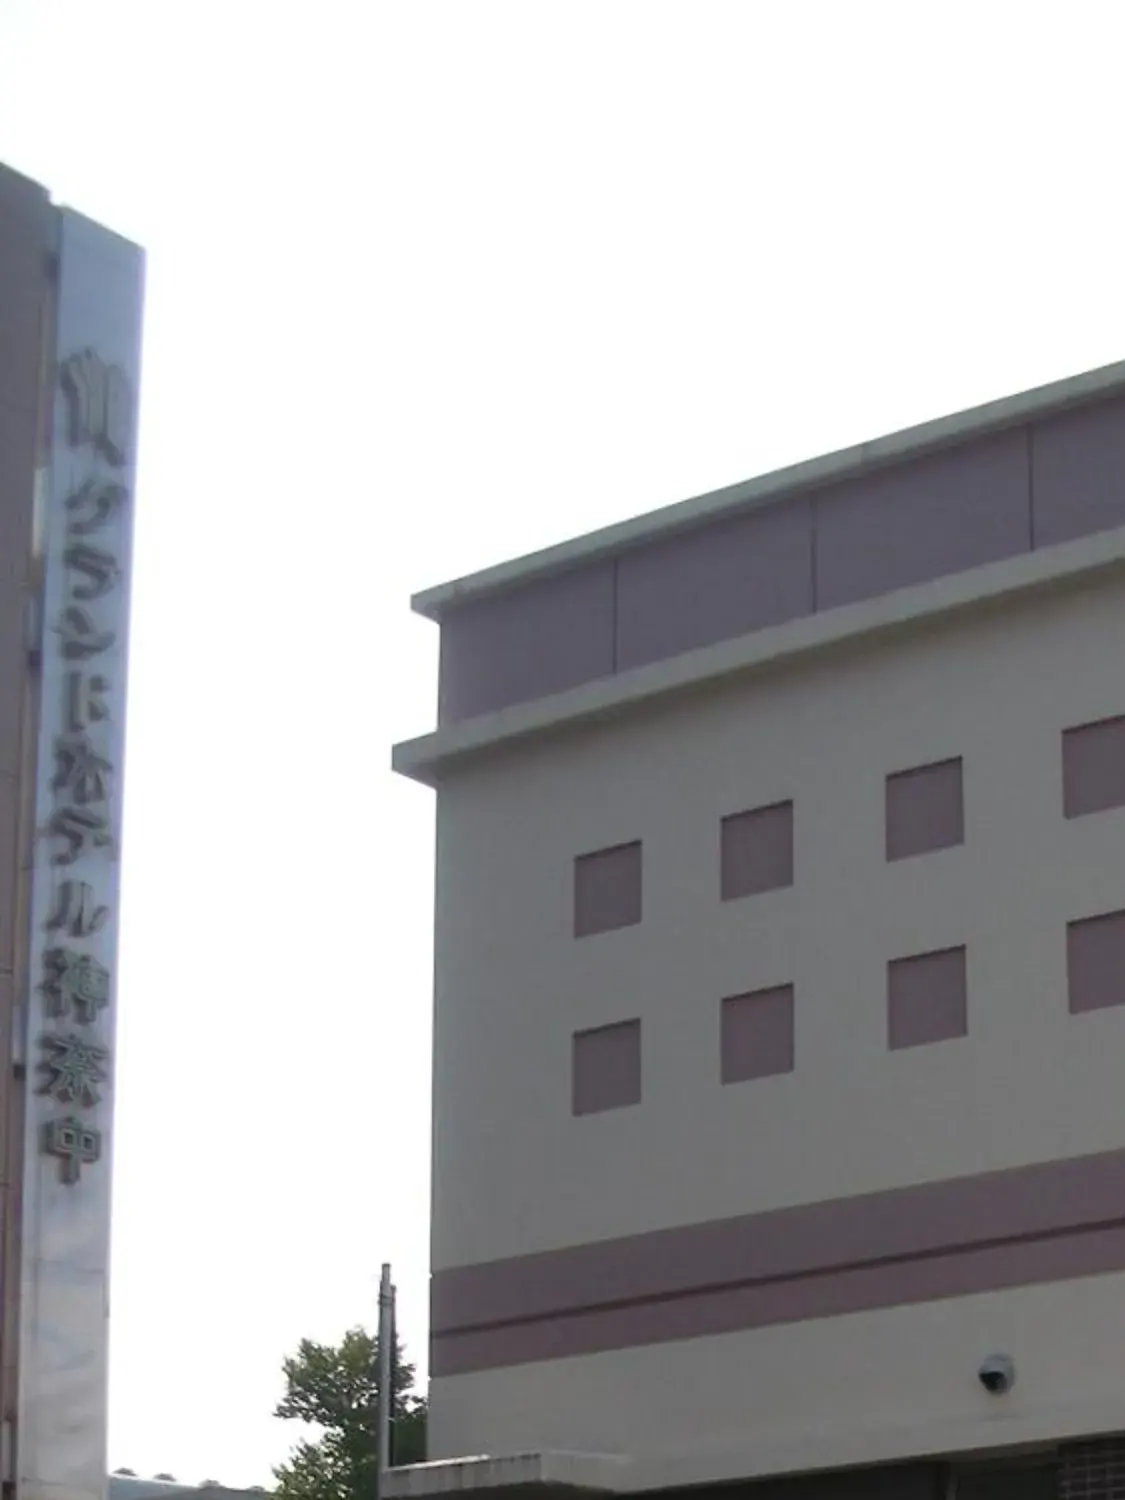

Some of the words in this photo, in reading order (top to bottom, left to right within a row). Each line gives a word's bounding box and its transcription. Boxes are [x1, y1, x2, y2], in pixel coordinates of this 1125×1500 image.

[34, 478, 127, 1186] グランドホテル神奈中
